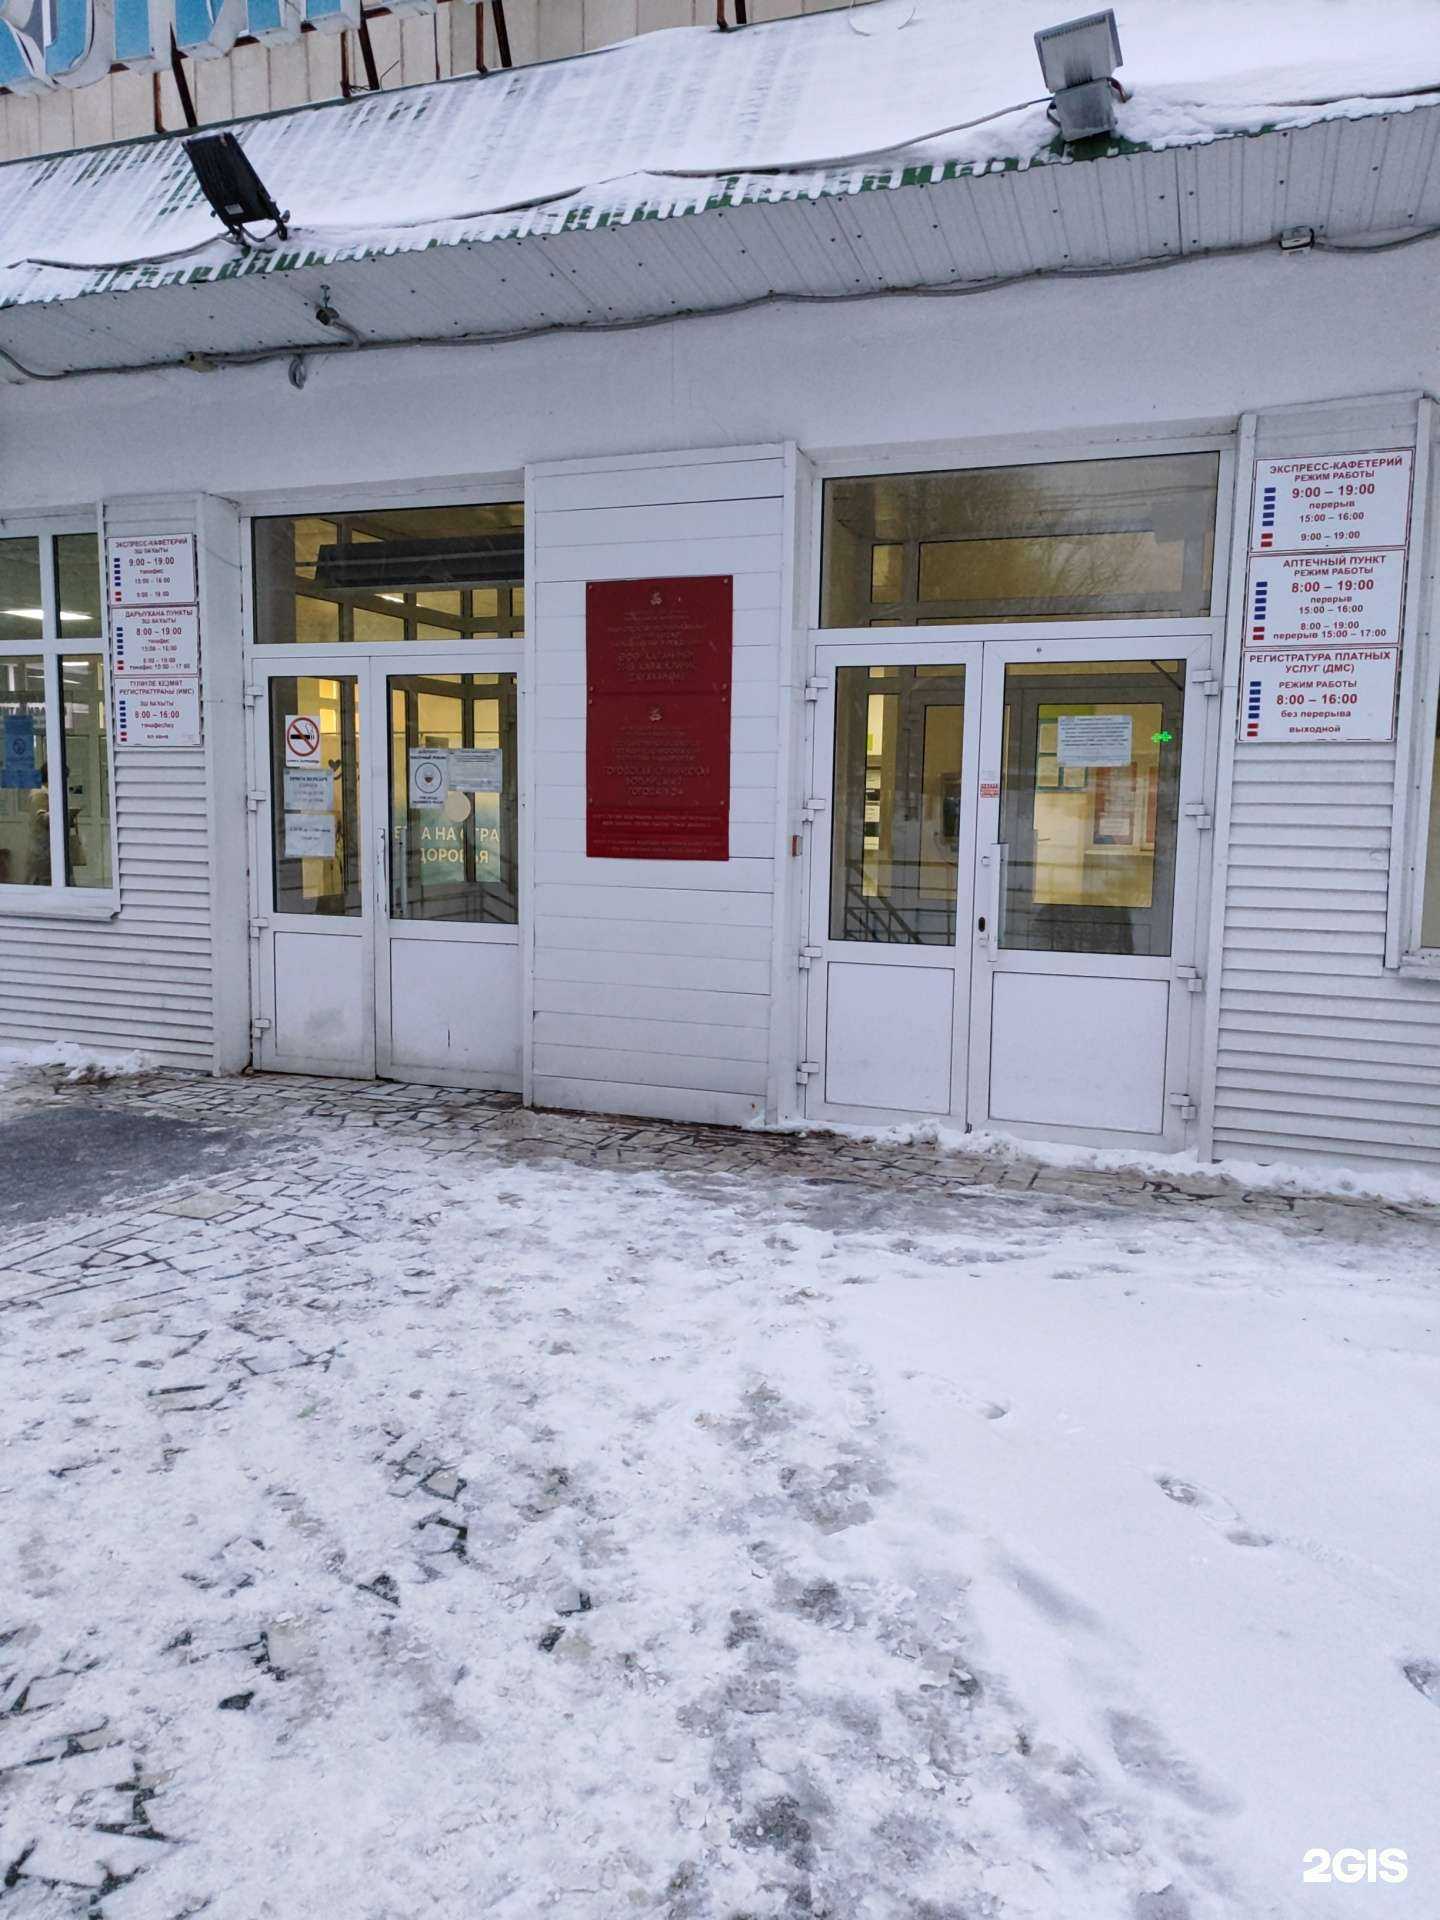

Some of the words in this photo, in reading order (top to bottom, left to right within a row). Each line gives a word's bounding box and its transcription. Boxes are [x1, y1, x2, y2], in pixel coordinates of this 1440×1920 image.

[1270, 456, 1402, 474] ЭКСПРЕСС-КАФЕТЕРИЙ
[1294, 474, 1330, 482] РЕЖИМ
[1333, 470, 1374, 479] РАБОТЫ
[1292, 487, 1321, 499] 9:00
[1338, 483, 1375, 496] 19:00
[1309, 501, 1355, 511] перерыв
[1300, 514, 1326, 523] 15:00
[1338, 512, 1365, 521] 16:00
[1301, 533, 1322, 541] 9:00
[1334, 531, 1360, 539] 19:00
[128, 558, 145, 566] 9:00
[154, 557, 175, 565] 19:00
[1283, 557, 1346, 568] АПТЕЧНЫЙ
[1350, 555, 1386, 565] ПУНКТ
[1294, 569, 1329, 577] РЕЖИМ
[1332, 566, 1373, 575] РАБОТЫ
[1291, 581, 1320, 593] 8:00
[1338, 579, 1374, 591] 19:00
[1310, 596, 1352, 605] перерыв
[1299, 606, 1325, 615] 15:00
[1337, 605, 1364, 613] 16:00
[1300, 622, 1321, 631] 8:00
[1333, 621, 1360, 629] 19:00
[136, 628, 152, 636] 8:00
[161, 627, 182, 635] 19:00
[1274, 632, 1318, 641] перерыв
[1322, 630, 1348, 639] 15:00
[1360, 629, 1386, 637] 17:00
[1250, 653, 1331, 663] РЕГИСТРАТУРА
[1335, 652, 1391, 661] ПЛАТНЫХ
[1286, 664, 1320, 674] УСЛУГ
[1323, 663, 1355, 674] (ДМС)
[1279, 681, 1313, 689] РЕЖИМ
[1316, 680, 1357, 688] РАБОТЫ
[1276, 694, 1304, 705] 8:00
[1322, 693, 1358, 704] 16:00
[135, 711, 151, 719] 8:00
[160, 710, 180, 719] 16:00
[1281, 710, 1297, 718] без
[1300, 710, 1351, 719] перерыва
[1289, 725, 1340, 734] выходной
